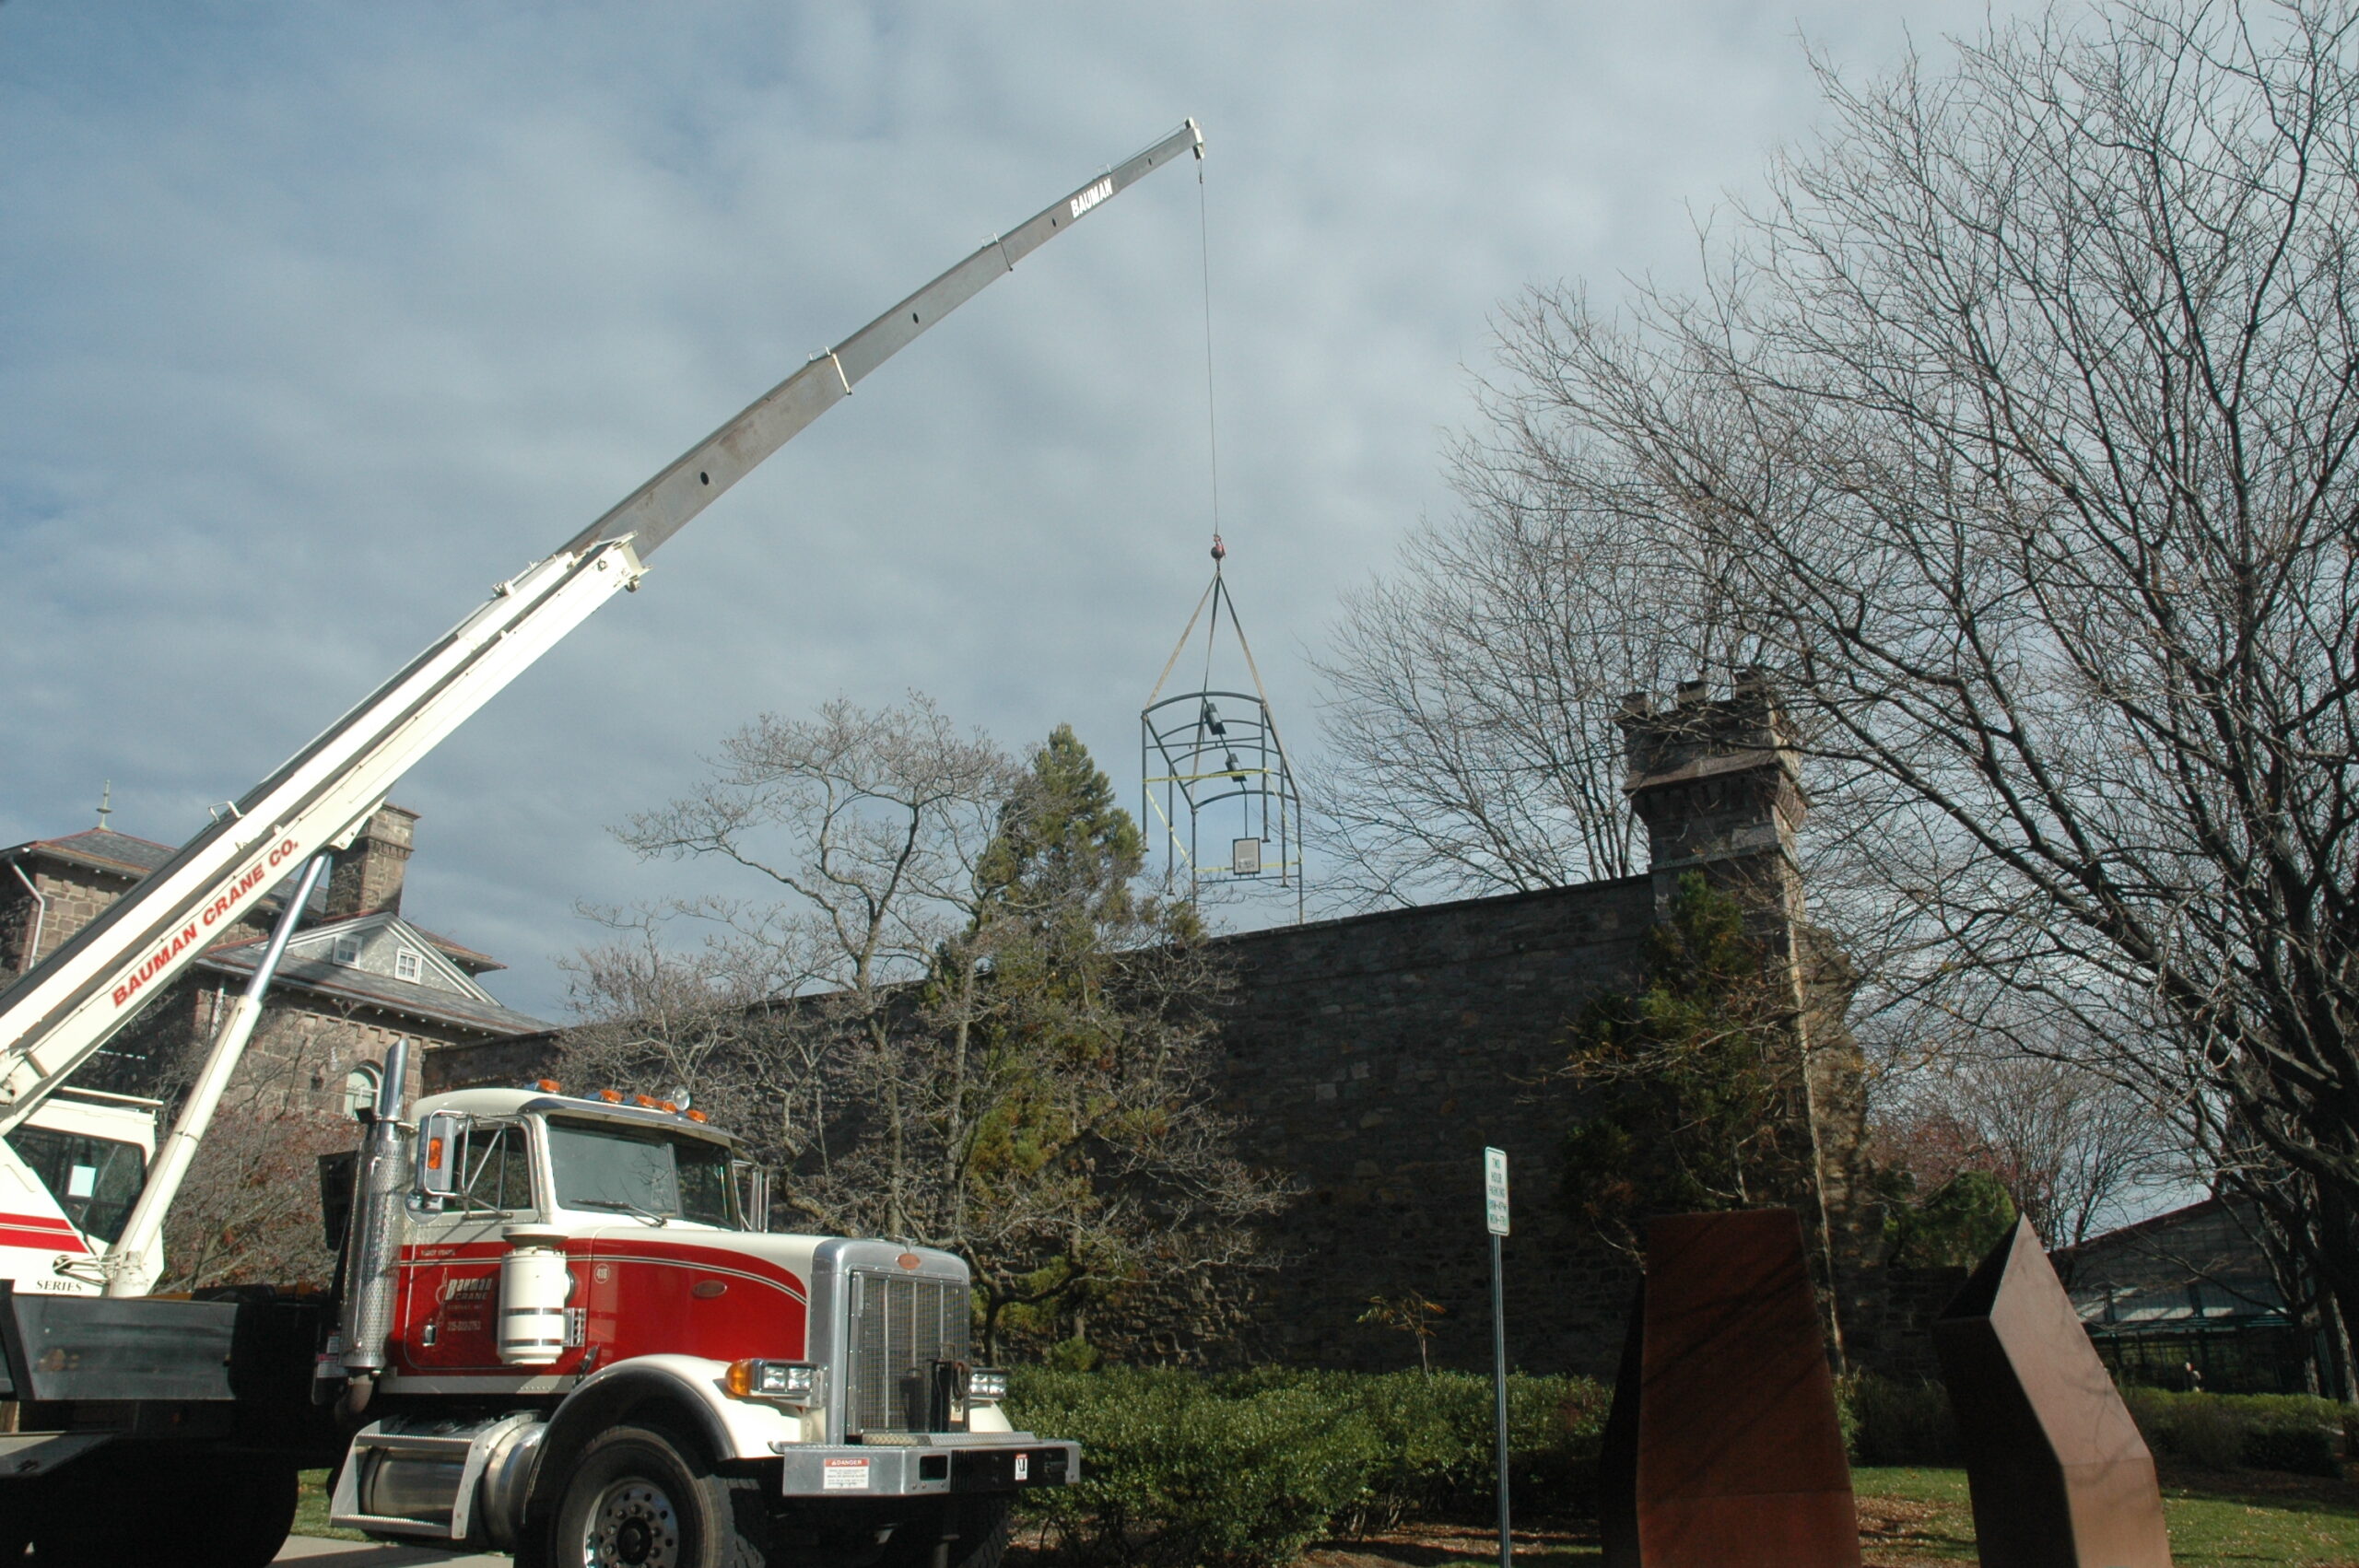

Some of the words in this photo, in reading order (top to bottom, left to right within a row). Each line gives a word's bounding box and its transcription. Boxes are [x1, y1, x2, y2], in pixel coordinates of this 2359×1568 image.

[1071, 178, 1113, 218] BAUMAN
[111, 923, 198, 1009] BAUMAN
[202, 863, 265, 927] CRANE
[268, 838, 299, 867] CO.
[36, 1280, 83, 1292] SERIES
[456, 1292, 487, 1300] CRANE
